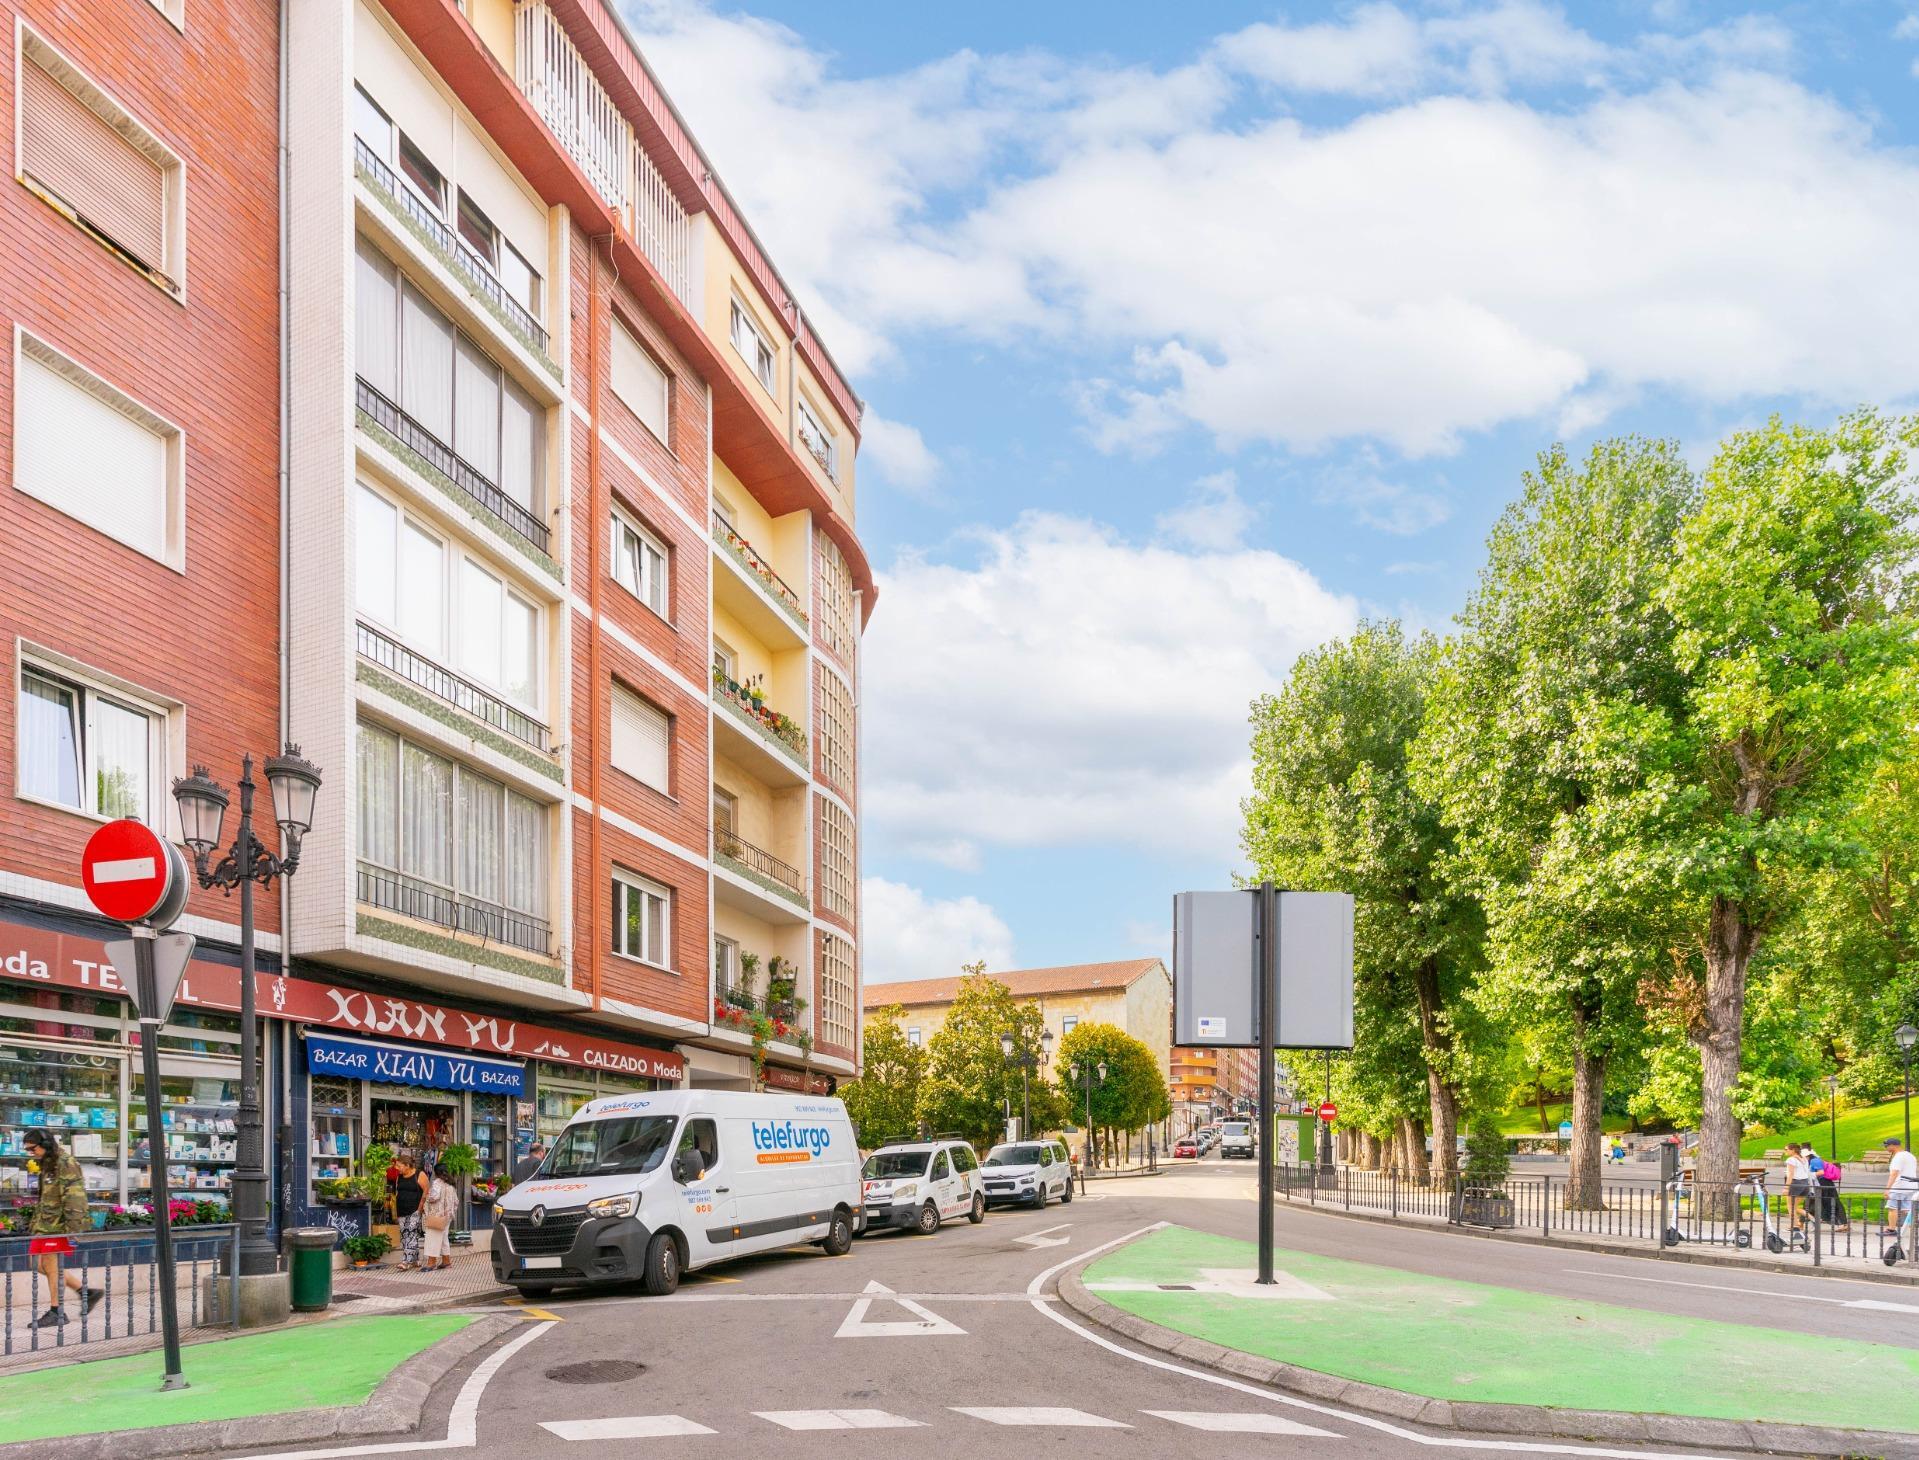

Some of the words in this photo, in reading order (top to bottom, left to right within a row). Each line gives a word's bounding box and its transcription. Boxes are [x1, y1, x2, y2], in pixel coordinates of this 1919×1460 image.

[0, 950, 51, 979] da
[326, 988, 447, 1041] XIAN
[461, 1013, 516, 1052] YU
[313, 1048, 368, 1068] BAZAR
[374, 1051, 435, 1081] XIAN
[448, 1061, 476, 1086] YU
[481, 1071, 521, 1087] BAZAR
[583, 1049, 648, 1073] CALZADO
[653, 1061, 682, 1079] Moda
[752, 1120, 830, 1157] telefurgo
